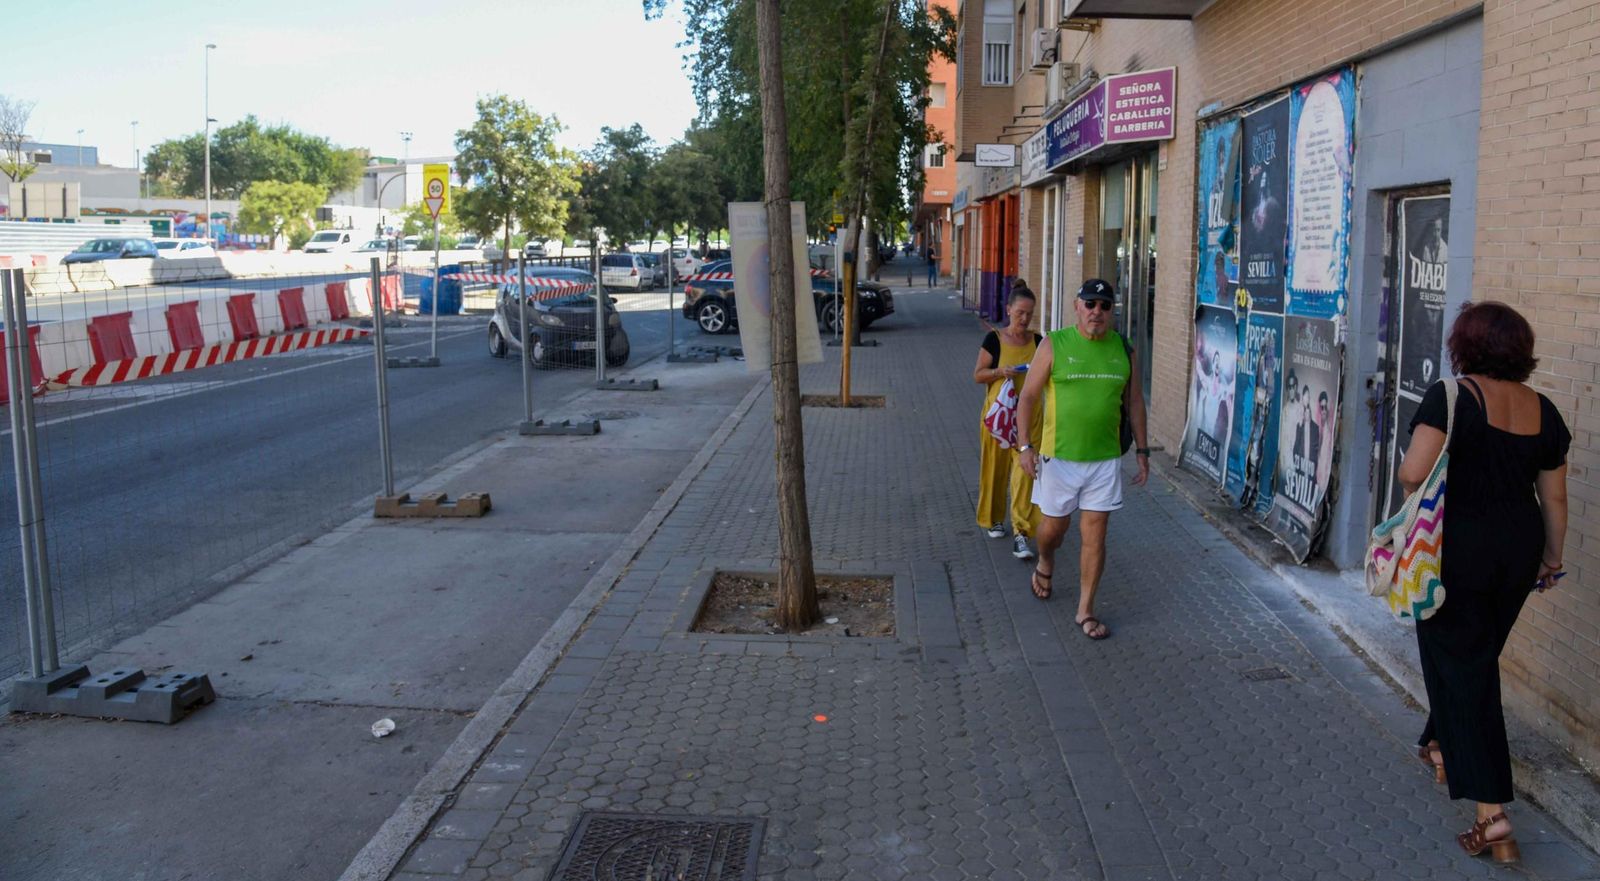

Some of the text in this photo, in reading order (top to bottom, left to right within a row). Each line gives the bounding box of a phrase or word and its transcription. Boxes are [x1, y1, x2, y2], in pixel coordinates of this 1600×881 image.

[1119, 82, 1161, 96] SEÑORA
[1115, 96, 1165, 109] ESTETICA
[1109, 106, 1171, 122] CABALLERO
[1114, 120, 1165, 134] BARBERIA
[430, 184, 442, 194] 50
[1247, 260, 1276, 278] SEVILLA
[1284, 468, 1319, 514] SEVILLA
